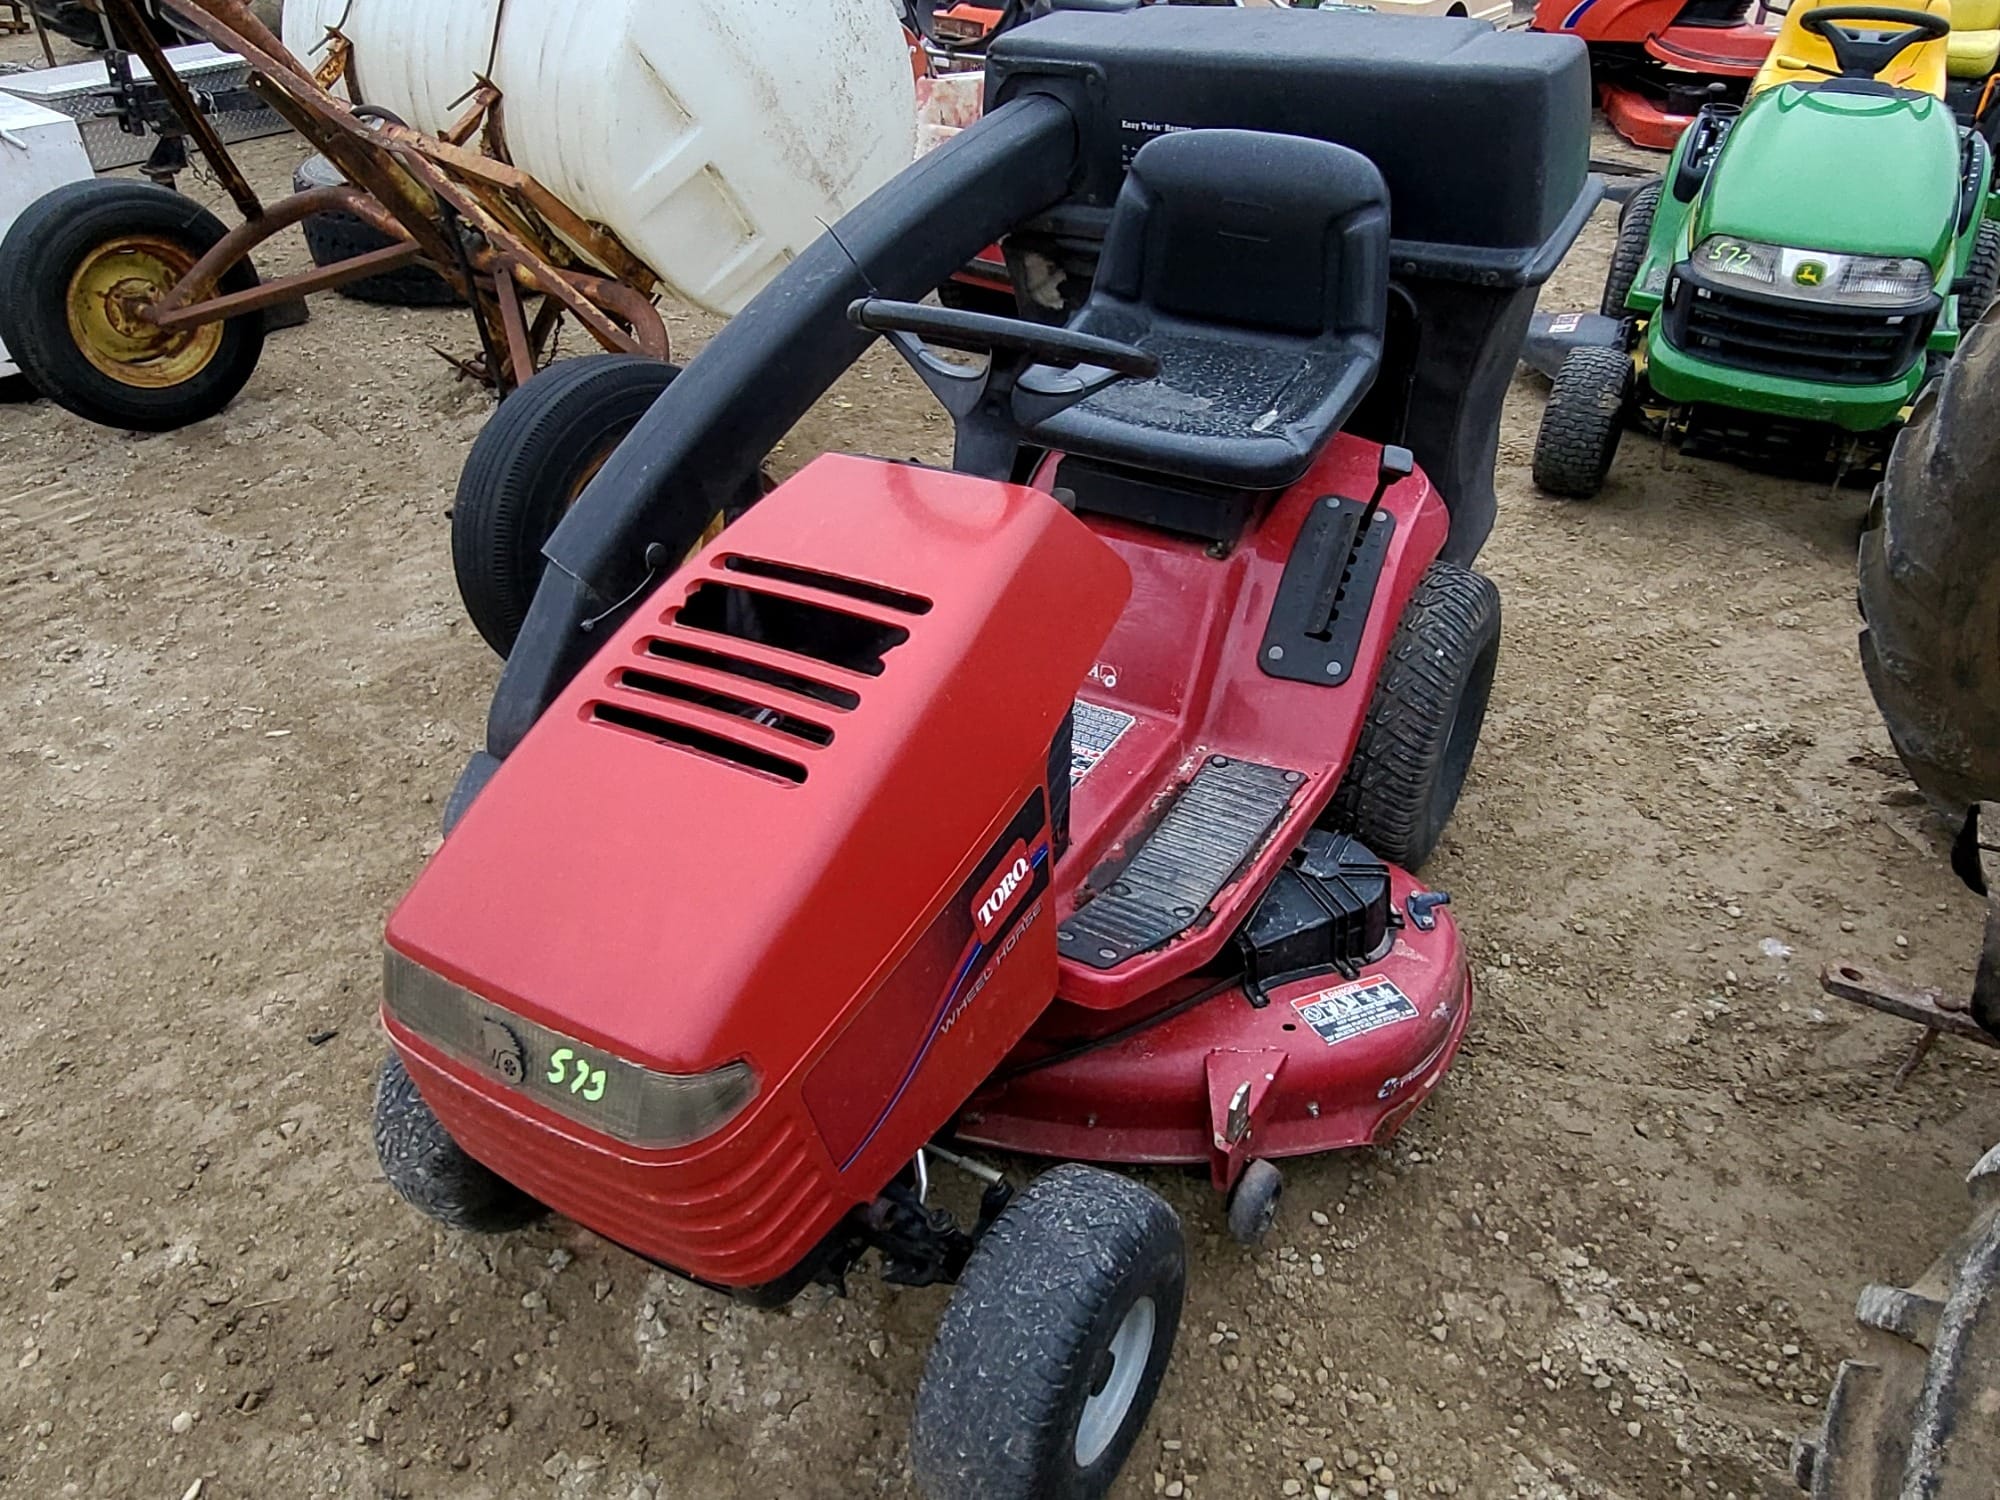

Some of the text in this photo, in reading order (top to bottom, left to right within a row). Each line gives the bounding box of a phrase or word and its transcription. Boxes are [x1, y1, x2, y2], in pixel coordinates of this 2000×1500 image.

[1121, 120, 1139, 131] Easy
[1141, 121, 1161, 131] Twin
[1709, 243, 1751, 271] 572
[978, 857, 1029, 928] TORO
[940, 902, 1042, 1034] WHEEL HORSE
